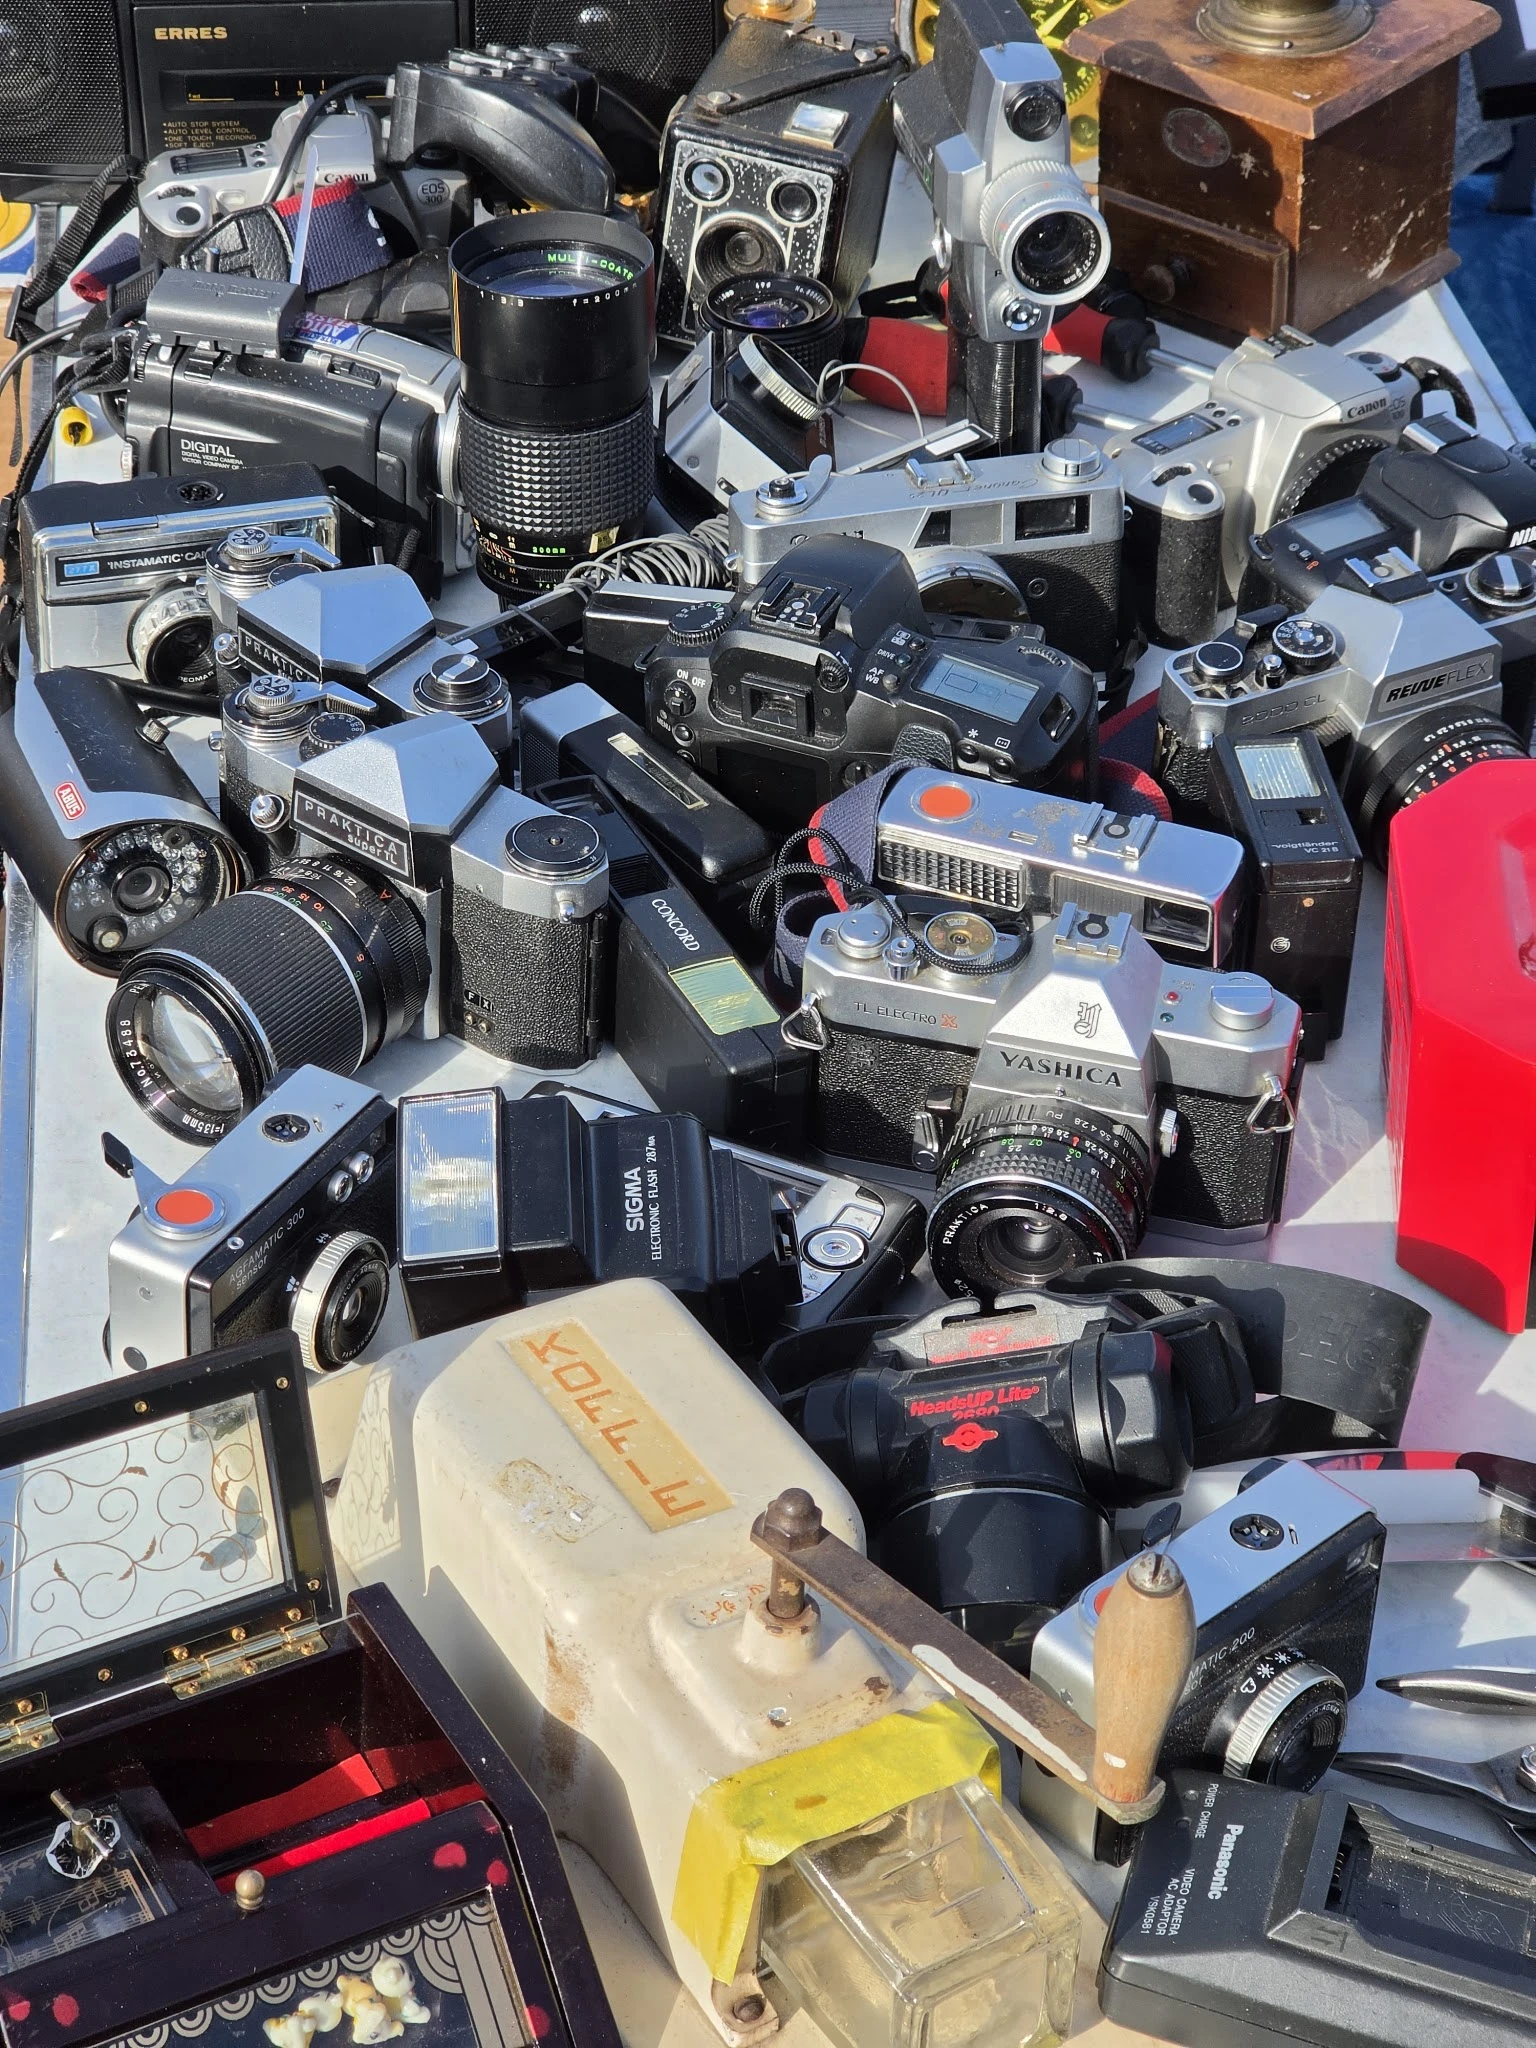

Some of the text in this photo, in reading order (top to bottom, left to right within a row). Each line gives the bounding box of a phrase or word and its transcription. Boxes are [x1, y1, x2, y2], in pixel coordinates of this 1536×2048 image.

[155, 26, 228, 40] ERRES
[421, 183, 445, 195] EOS
[1347, 397, 1388, 419] Canon
[181, 438, 236, 458] DIGITAL
[181, 450, 244, 465] DIGITAL VIDEO CAMERA
[181, 456, 202, 465] VICTOR
[203, 460, 231, 469] COMPANY
[532, 546, 566, 554] 200mm
[876, 648, 896, 661] DRIVE
[676, 668, 707, 688] ON OFF
[865, 673, 880, 685] WB
[868, 666, 885, 677] AF
[656, 715, 672, 732] MENU
[59, 787, 82, 816] ABUS
[304, 800, 398, 854] PRAKTICA
[347, 834, 383, 857] super
[322, 864, 333, 872] 11
[333, 869, 345, 878] 16
[343, 876, 357, 886] 22
[298, 892, 310, 902] 15
[313, 902, 325, 912] 10
[380, 888, 392, 901] A
[651, 898, 700, 951] CONCORD
[468, 991, 489, 1010] F X
[852, 1001, 958, 1030] TL ELECTRO X
[999, 1050, 1123, 1089] YASHICA
[1056, 1127, 1070, 1138] 2.8
[1074, 1117, 1090, 1128] 2.8
[1090, 1124, 1098, 1133] 4
[1028, 1138, 1043, 1147] 0.7
[1085, 1140, 1097, 1151] 2.8
[1099, 1130, 1112, 1142] 5.6
[1113, 1139, 1120, 1148] 8
[1007, 1144, 1023, 1153] 2.5
[1065, 1154, 1072, 1162] 2
[1067, 1148, 1082, 1159] 0.6
[646, 1169, 659, 1199] FLASH
[623, 1166, 645, 1232] SIGMA
[648, 1202, 662, 1261] ELECTRONIC
[942, 1203, 989, 1245] PRAKTICA
[229, 1207, 306, 1287] AGFAMATIC 300
[236, 1255, 268, 1291] sensor
[910, 1390, 995, 1418] HeadsUP
[523, 1330, 707, 1518] KOFFIE
[1188, 1627, 1256, 1680] MATIC 200
[1194, 1783, 1220, 1839] POWER CHARGE
[1207, 1823, 1245, 1900] Panasonic
[1155, 1877, 1180, 1936] AC ADAPTOR
[1167, 1868, 1196, 1937] VIDEO CAMERA
[1140, 1895, 1161, 1935] VSK0581
